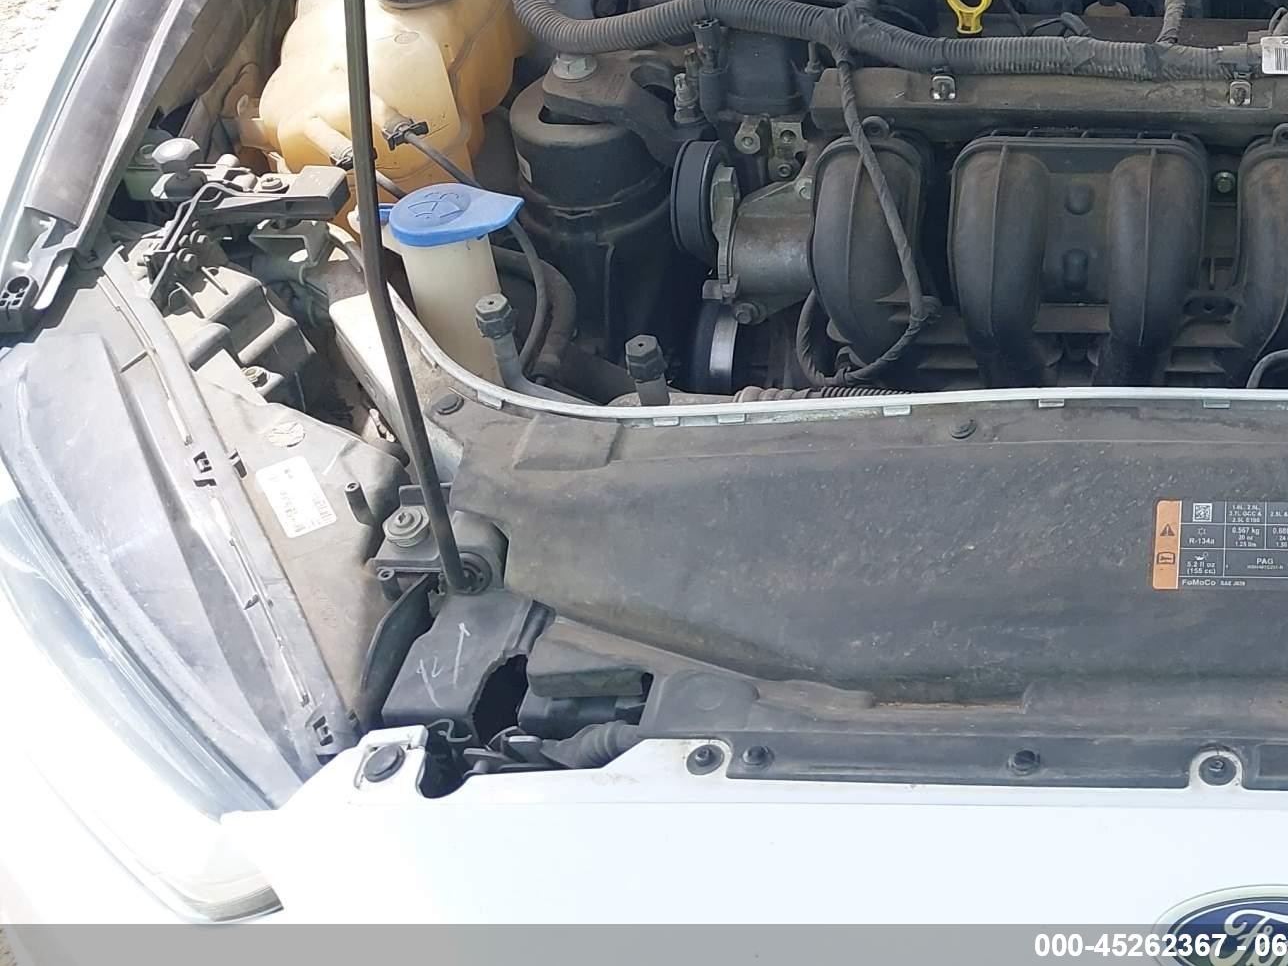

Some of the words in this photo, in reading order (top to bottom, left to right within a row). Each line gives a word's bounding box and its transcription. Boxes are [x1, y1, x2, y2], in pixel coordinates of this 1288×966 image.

[1251, 527, 1260, 535] kg
[1189, 537, 1215, 545] R-134a
[1256, 557, 1274, 565] PAG
